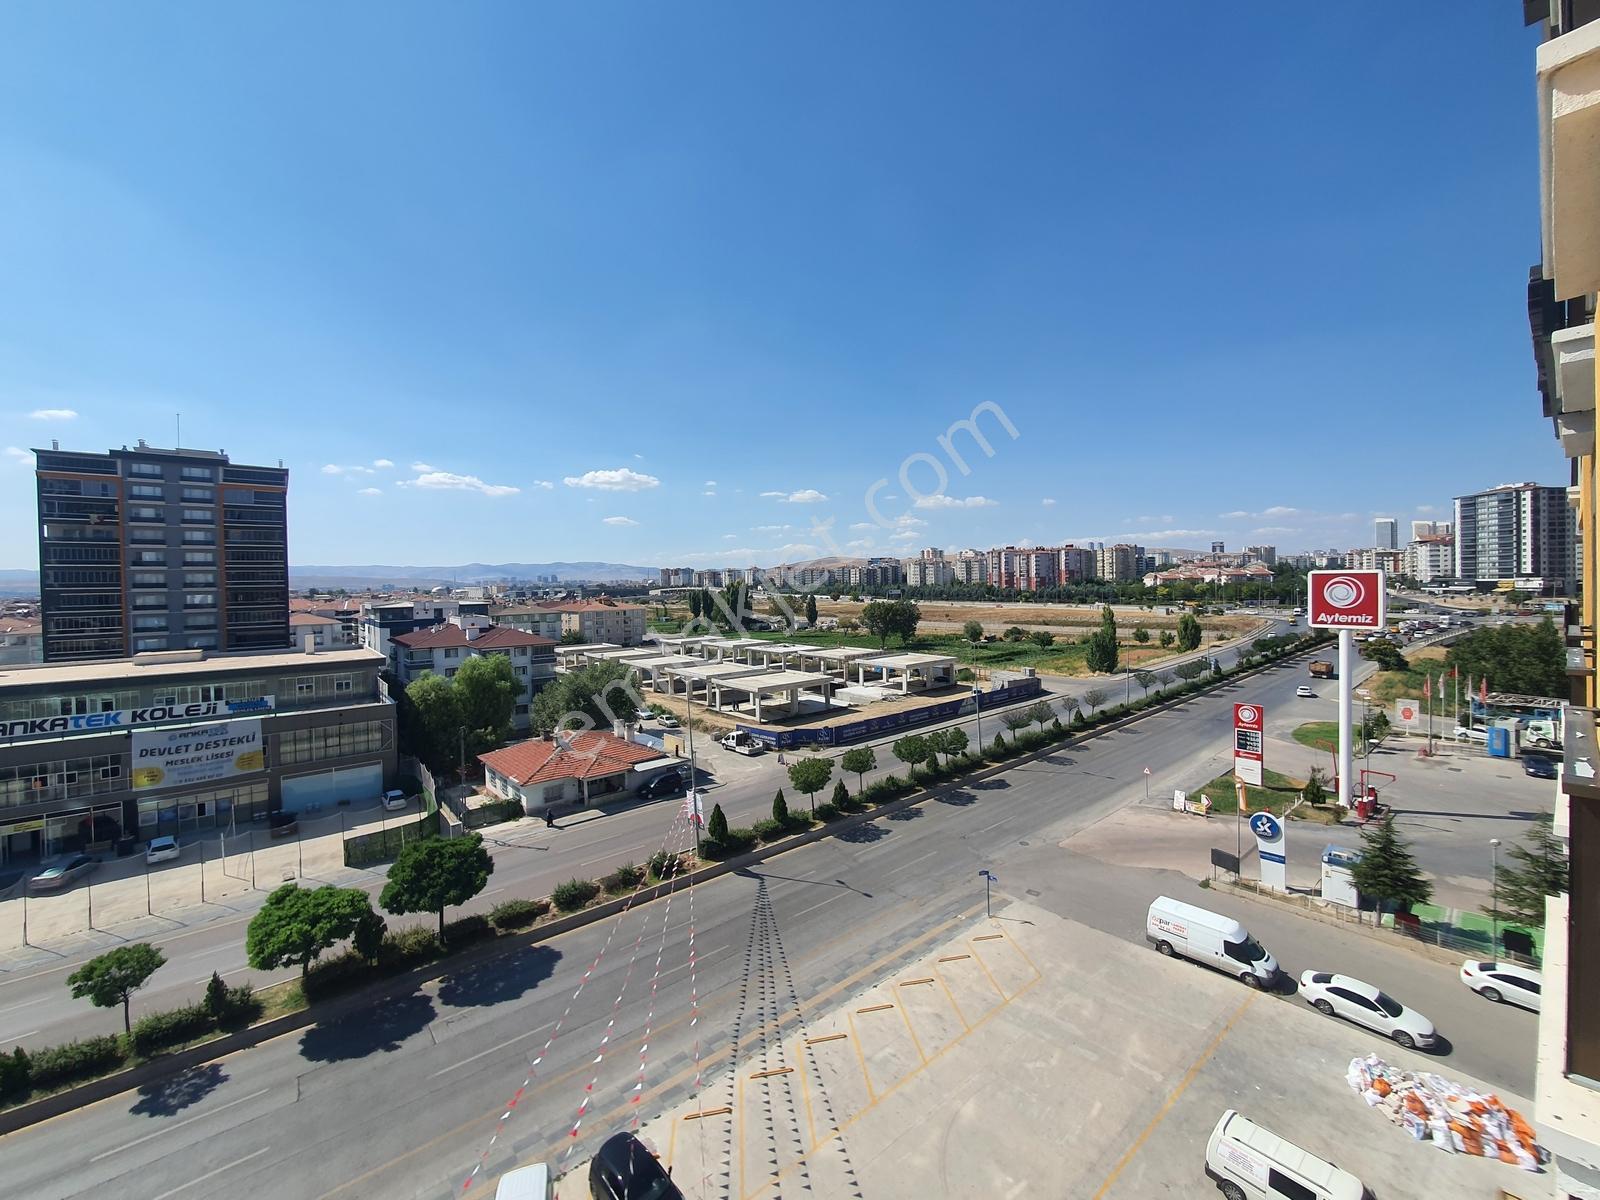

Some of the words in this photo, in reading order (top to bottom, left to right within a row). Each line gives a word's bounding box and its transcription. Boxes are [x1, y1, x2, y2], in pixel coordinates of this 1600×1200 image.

[1316, 612, 1374, 624] Aytemiz
[139, 743, 192, 758] DEVLET
[194, 731, 256, 752] DESTEKLİ
[165, 755, 203, 767] MESLEK
